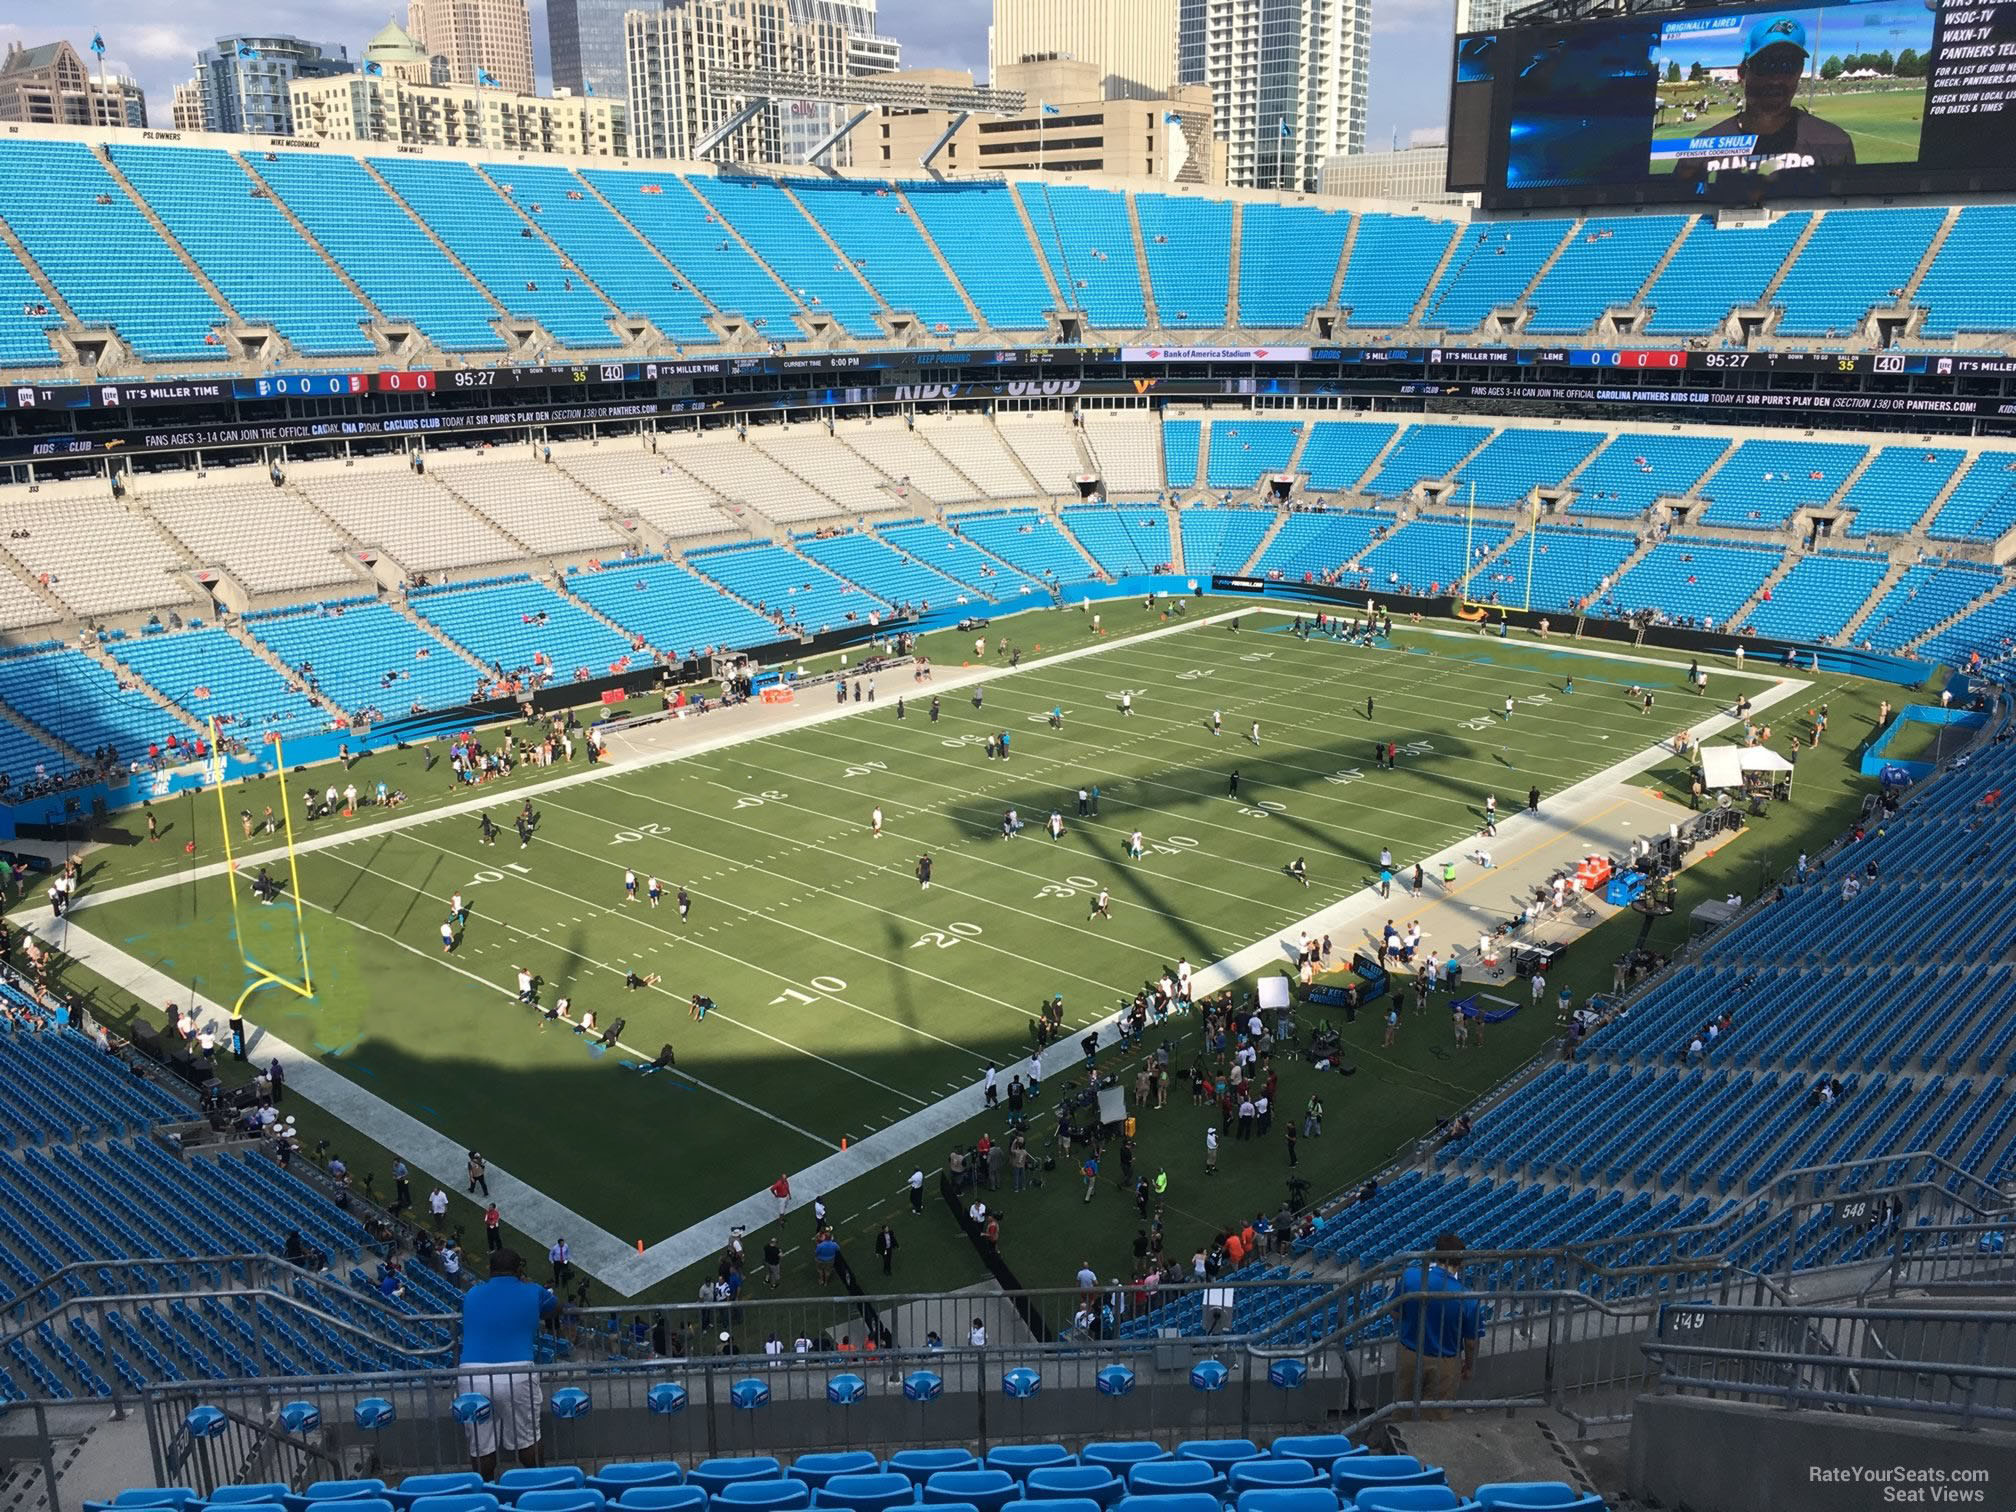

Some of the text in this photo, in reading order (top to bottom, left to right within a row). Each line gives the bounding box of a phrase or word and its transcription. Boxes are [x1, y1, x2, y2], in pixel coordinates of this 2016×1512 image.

[1945, 9, 1996, 25] WSOC-TV
[1665, 18, 1737, 32] ORIGINALLY AIRED
[1943, 27, 1992, 43] WAXN-TV
[1940, 45, 1996, 60] PANTHERS
[1935, 64, 2005, 76] FOR A LIST OF OUR
[1934, 78, 1961, 88] CHECK:
[1932, 92, 2003, 103] CHECK YOUR LOCAL
[1930, 103, 2004, 115] FOR DATES & TIMES
[143, 131, 181, 141] PSL OWNERS
[1689, 135, 1752, 149] MIKE SHULA
[270, 139, 320, 148] MIKE MCCORMACK
[397, 145, 423, 154] SAM MILLS
[1708, 148, 1750, 156] COORDINATOR
[1163, 350, 1251, 358] Bank of America Stadium
[1446, 352, 1459, 360] IT'S
[1461, 352, 1488, 360] MILLER
[1489, 353, 1507, 361] TIME
[1592, 352, 1600, 365] 0
[1669, 354, 1678, 366] 0
[1706, 354, 1749, 367] 95:27
[661, 364, 719, 375] IT'S MILLER TIME
[830, 358, 860, 367] 6:00 PM
[1838, 361, 1854, 371] 35
[1879, 358, 1900, 371] 40
[1959, 362, 1978, 371] IT'S
[455, 371, 495, 386] 95:27
[573, 371, 586, 382] 35
[604, 366, 621, 379] 40
[276, 379, 287, 393] 0
[301, 378, 311, 393] 0
[329, 378, 340, 393] 0
[390, 375, 400, 389] 0
[417, 375, 427, 389] 0
[126, 386, 219, 400] IT'S MILLER TIME
[1471, 387, 1977, 412] FANS AGES 3-14 CAN JOIN THE OFFICIAL CAROLINA PANTHERS KIDS CLUB TODAY AT SIR PURR'S PLAY DEN (SECTION 138) OR PANTHERS.COM!
[146, 404, 658, 447] FANS AGES 3-14 CAN JOIN THE CLUB TODAY AT SIR PURR'S PLAY DEN (SECTION 138) OR PANTHERS.COM!
[33, 441, 92, 455] KIDS CLUB
[1518, 694, 1553, 706] 10
[1457, 717, 1497, 731] 20
[845, 760, 888, 776] 40
[1324, 769, 1365, 785] 40
[737, 790, 788, 807] 30
[1238, 801, 1287, 818] 50
[614, 823, 671, 842] 20
[1151, 835, 1199, 856] 40
[473, 862, 533, 883] 10
[1040, 875, 1098, 898] 30
[919, 921, 983, 949] 20
[782, 975, 848, 1006] 10
[1842, 1202, 1866, 1219] 548
